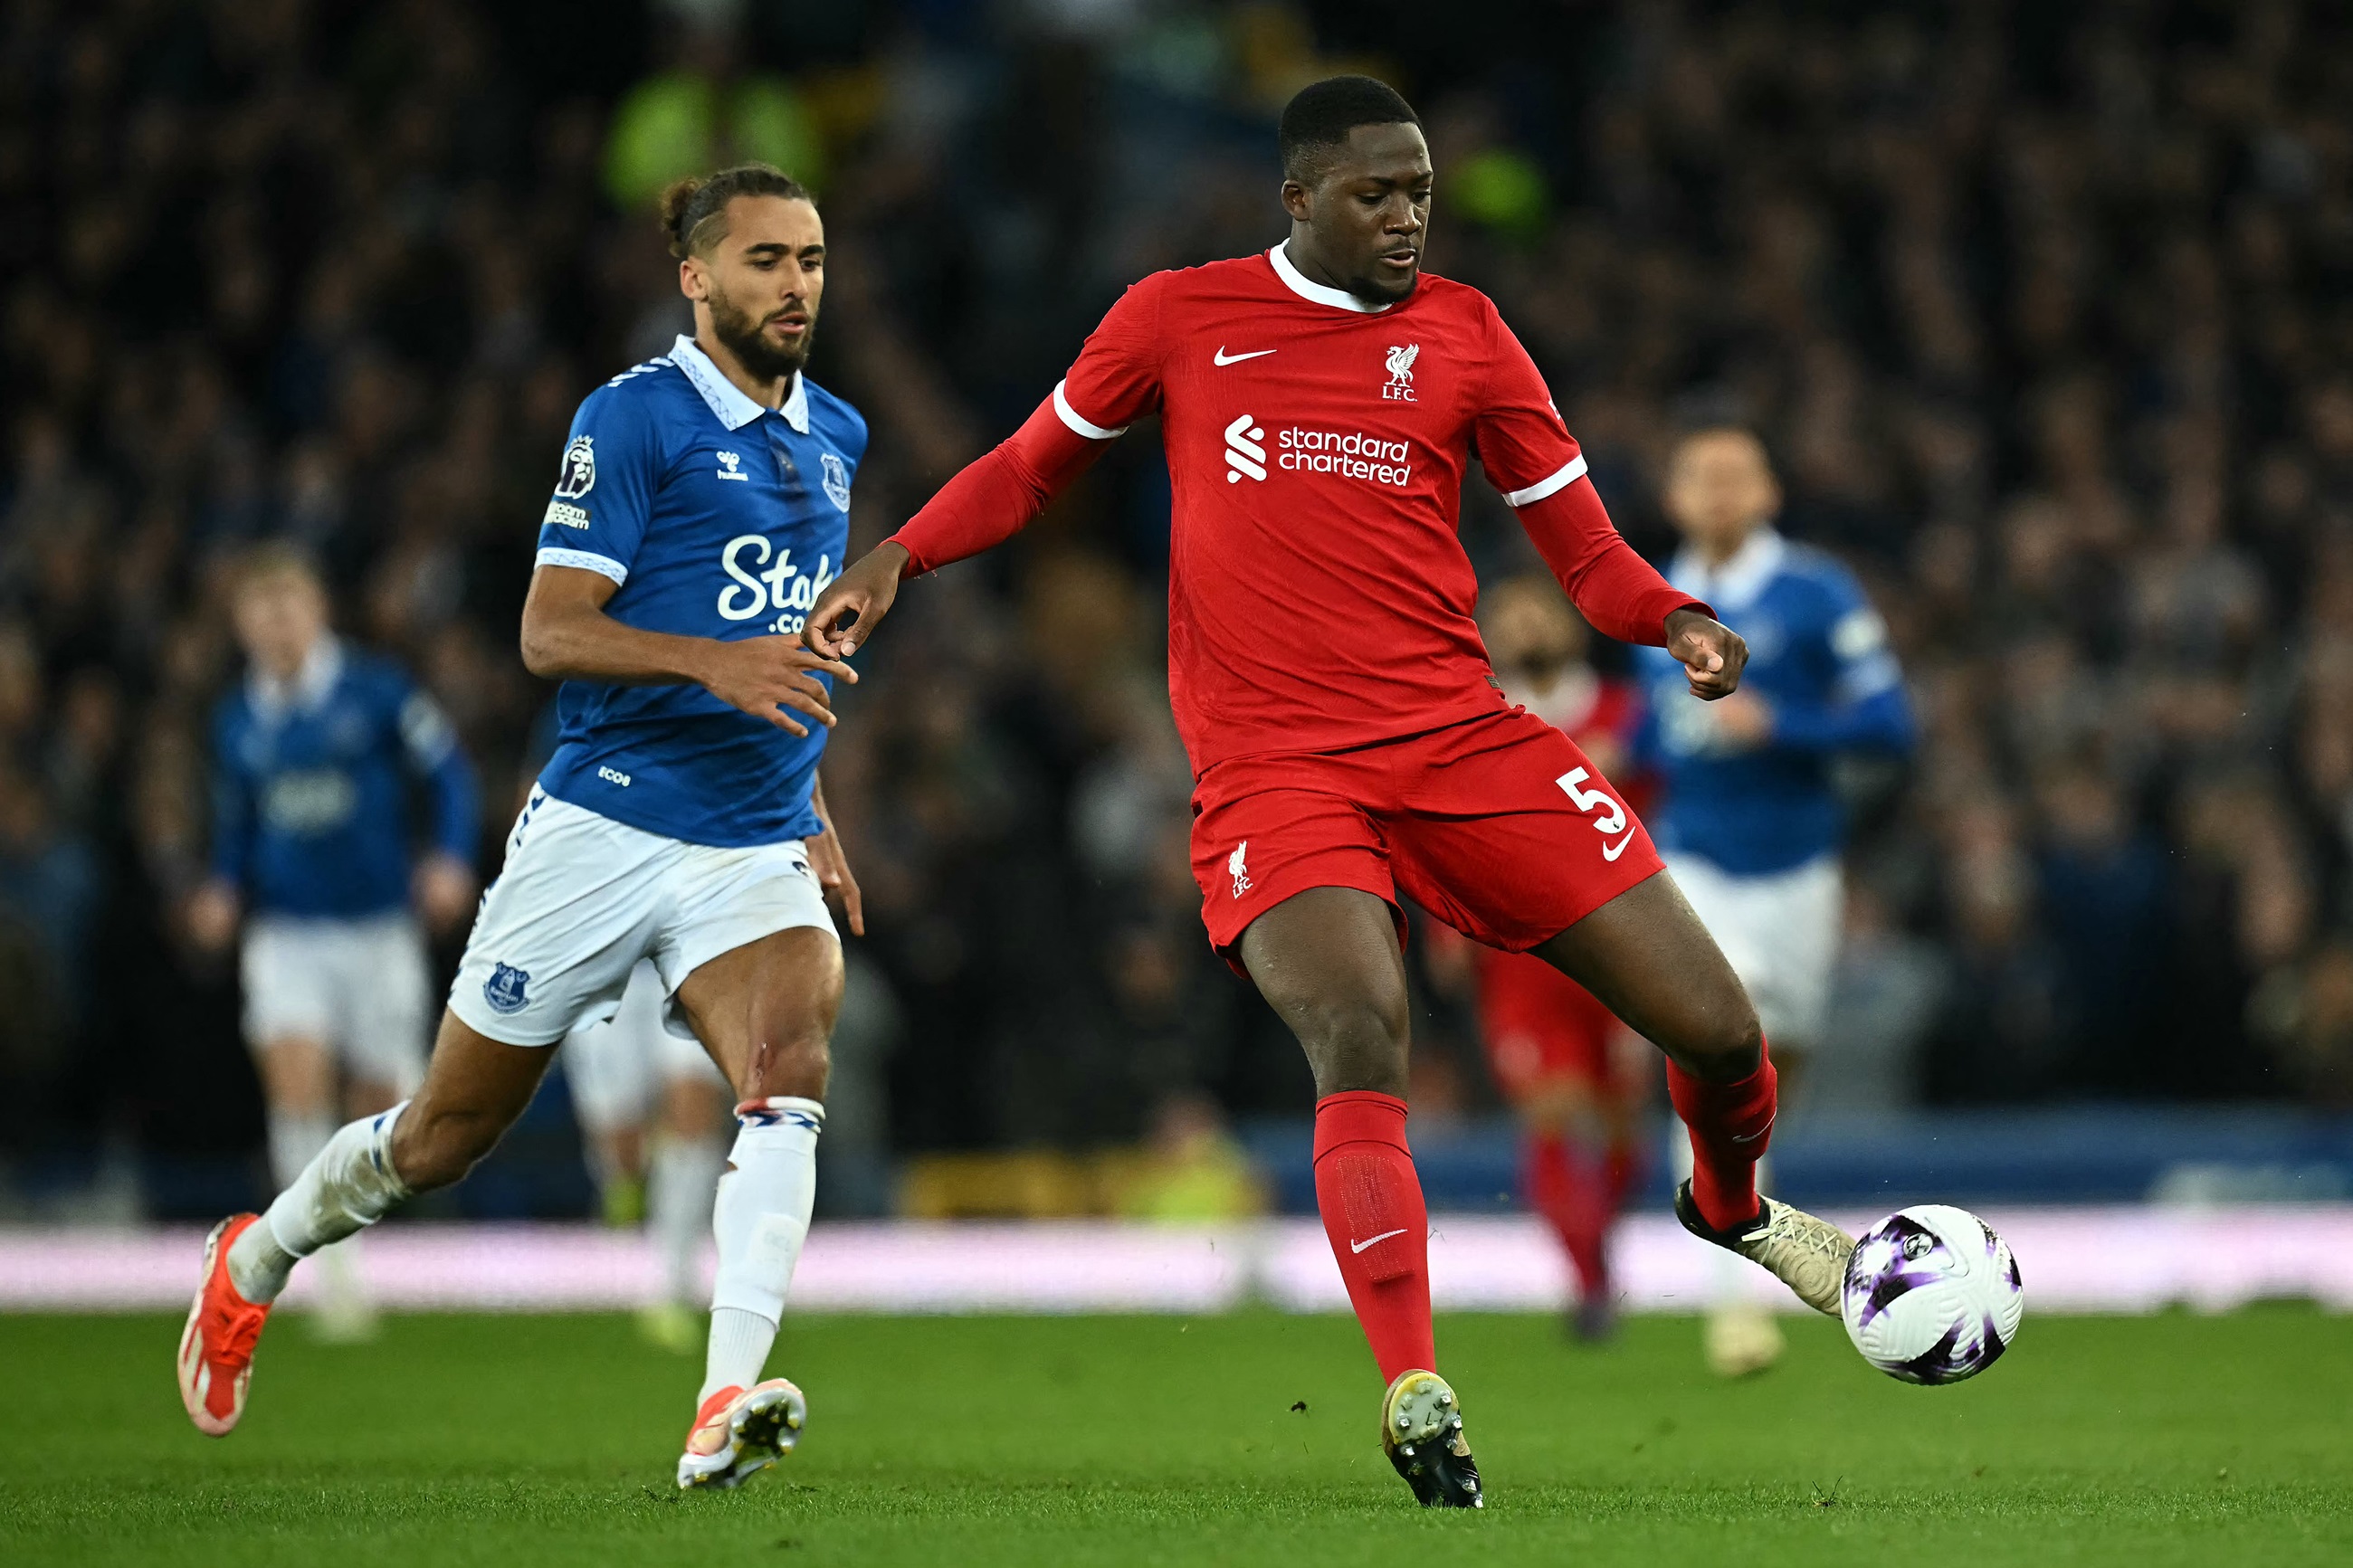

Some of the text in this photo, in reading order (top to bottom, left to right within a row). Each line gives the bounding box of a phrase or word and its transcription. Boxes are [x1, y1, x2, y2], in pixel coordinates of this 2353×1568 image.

[1279, 426, 1409, 463] standard
[1278, 449, 1412, 487] chartered
[717, 533, 834, 621] Stak
[768, 613, 807, 634] .co
[1555, 765, 1627, 834] 5
